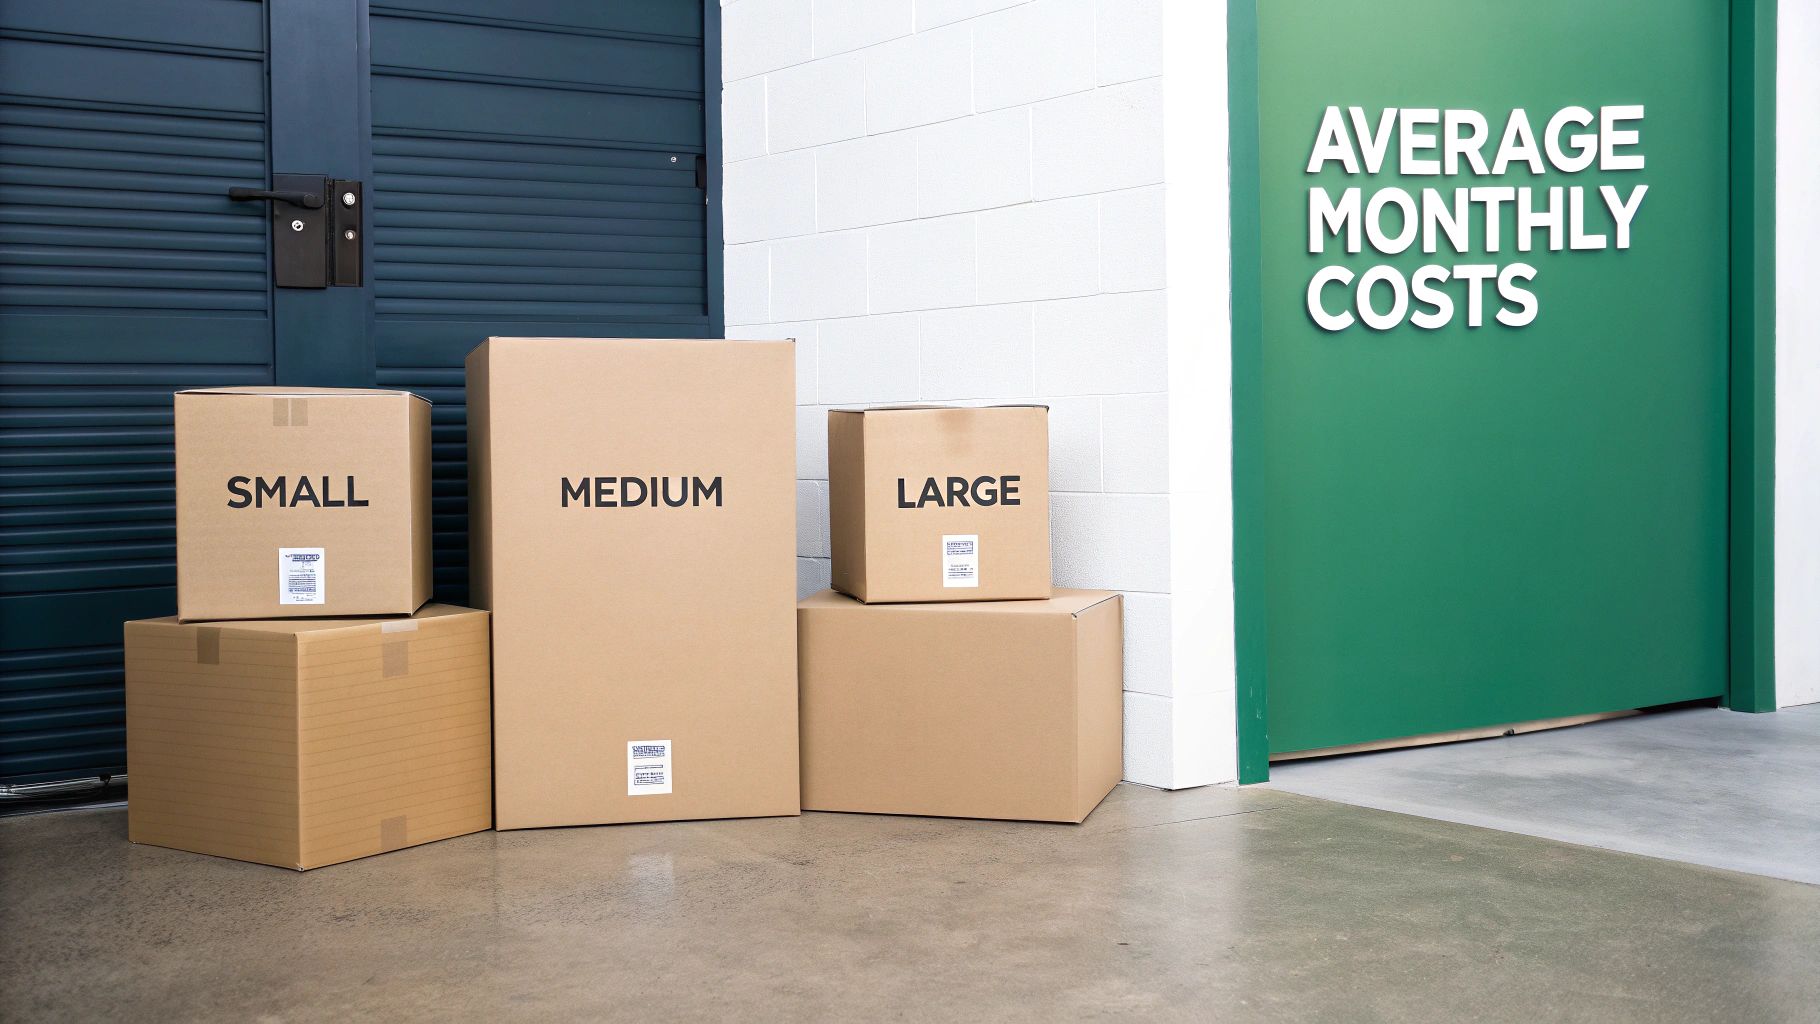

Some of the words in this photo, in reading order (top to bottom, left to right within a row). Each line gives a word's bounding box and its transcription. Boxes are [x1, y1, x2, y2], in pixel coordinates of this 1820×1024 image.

[1307, 105, 1645, 174] AVERAGE
[1309, 185, 1649, 254] MONTHLY
[1307, 263, 1539, 331] COSTS
[227, 475, 369, 509] SMALL
[561, 476, 723, 508] MEDIUM
[898, 475, 1021, 509] LARGE
